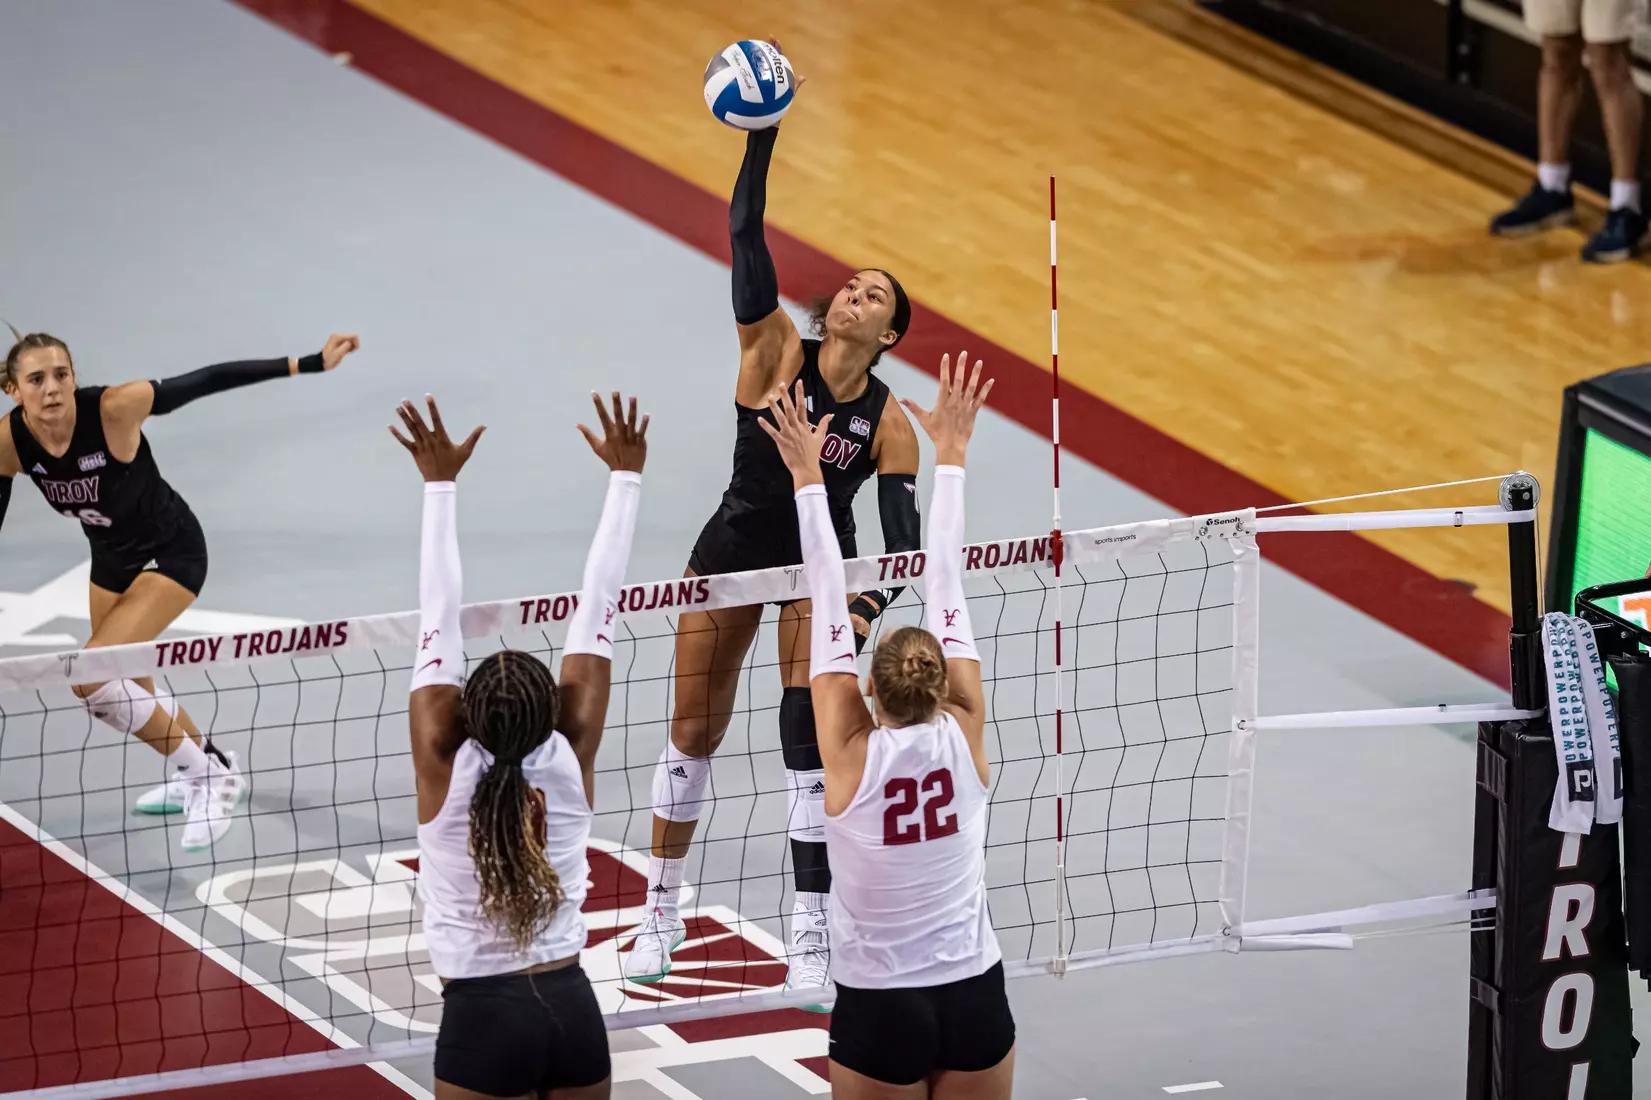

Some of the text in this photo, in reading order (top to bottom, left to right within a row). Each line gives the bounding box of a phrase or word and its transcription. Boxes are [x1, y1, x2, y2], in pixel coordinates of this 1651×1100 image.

[41, 475, 98, 503] TROY
[1094, 533, 1137, 546] sports imports
[1213, 516, 1241, 526] Senoh
[877, 536, 1055, 582] TRO ROJAN
[155, 620, 349, 668] TROY TROJANS
[882, 767, 961, 846] 22
